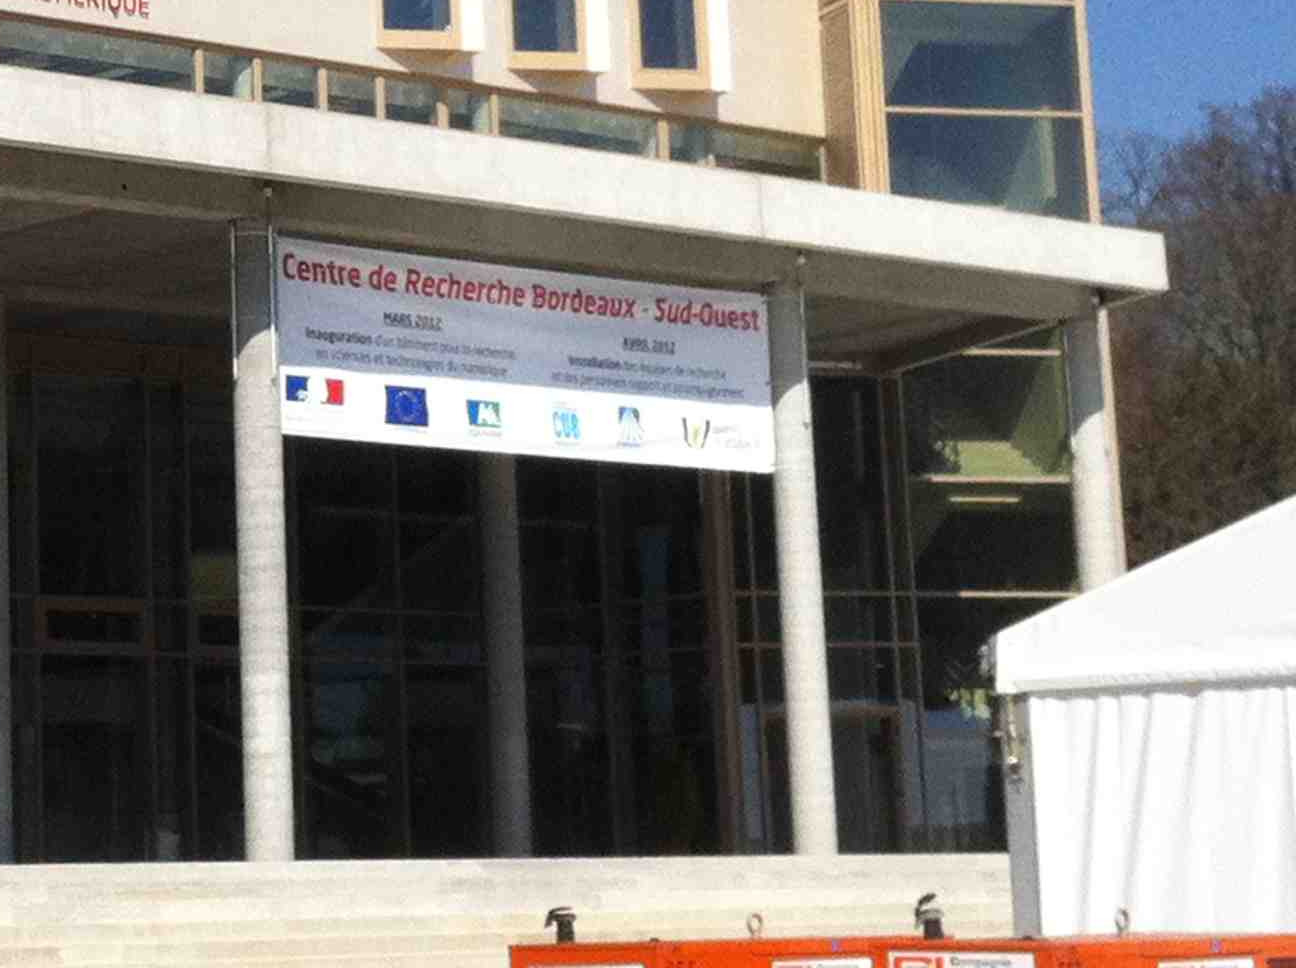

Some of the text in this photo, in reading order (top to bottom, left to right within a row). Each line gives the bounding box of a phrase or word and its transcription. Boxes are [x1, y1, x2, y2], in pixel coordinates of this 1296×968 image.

[282, 252, 361, 288] Centre
[368, 264, 397, 293] de
[405, 267, 526, 307] Recherche
[531, 284, 636, 319] Bordeaux
[654, 297, 761, 331] Sud-Ouest
[383, 311, 443, 331] MARS 2012
[305, 326, 372, 345] Inauguration
